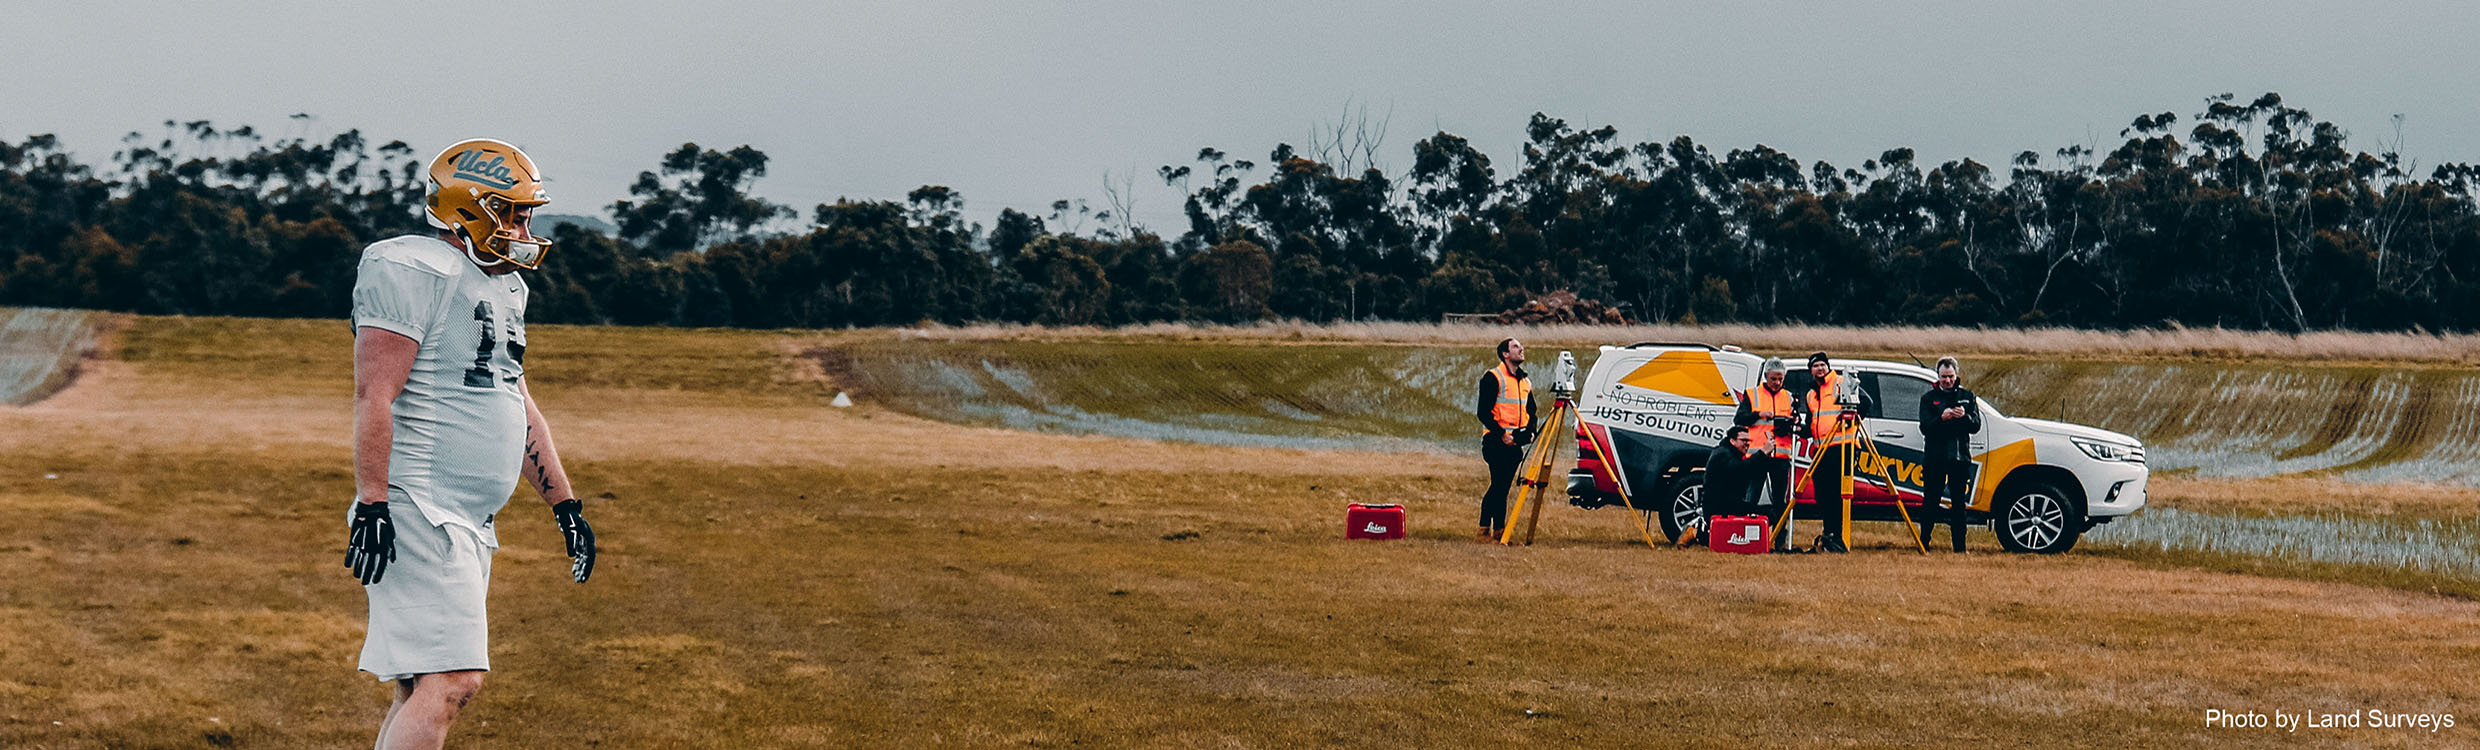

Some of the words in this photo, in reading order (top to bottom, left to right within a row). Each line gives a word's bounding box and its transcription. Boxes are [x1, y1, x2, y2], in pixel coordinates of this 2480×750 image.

[1610, 390, 1632, 405] NO
[1636, 394, 1717, 422] PROBLEMS
[1593, 405, 1632, 422] JUST
[1634, 412, 1724, 440] SOLUTIONS
[1363, 521, 1387, 534] Leica
